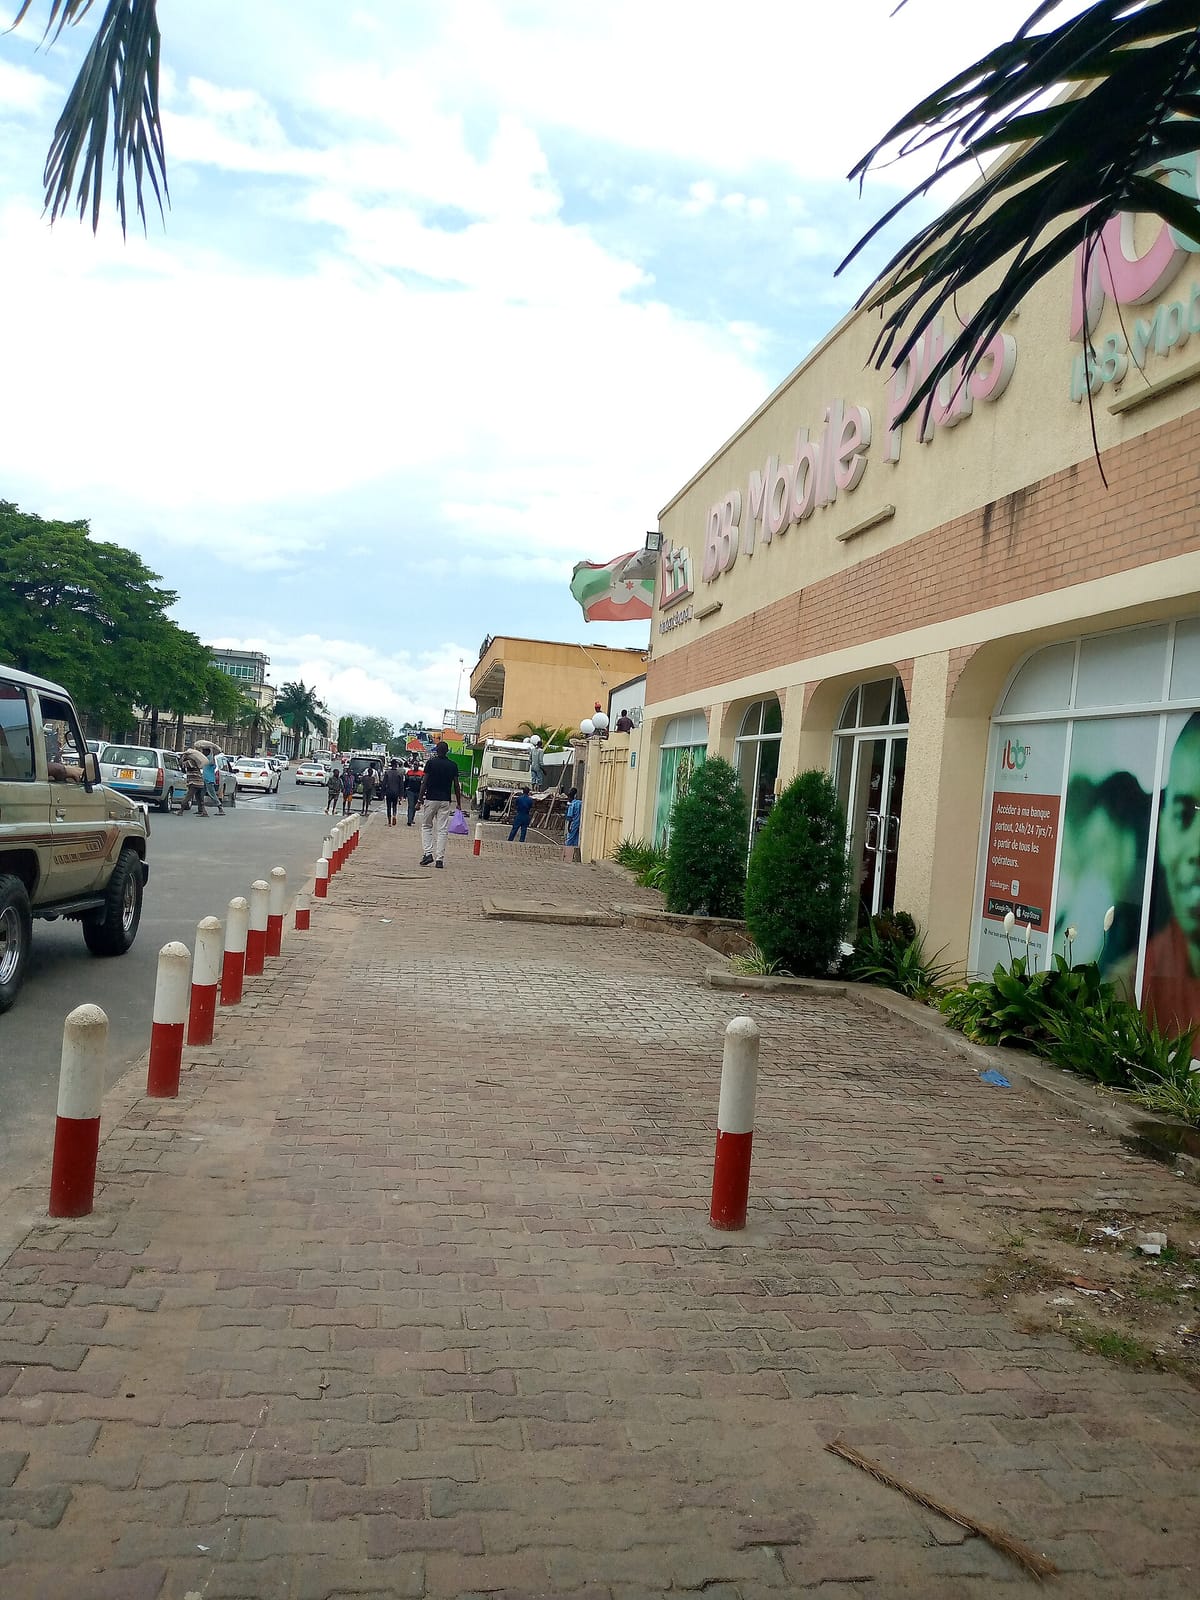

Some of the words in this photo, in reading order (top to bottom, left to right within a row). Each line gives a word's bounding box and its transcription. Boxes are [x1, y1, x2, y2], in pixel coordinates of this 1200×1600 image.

[743, 398, 872, 556] Mobile
[996, 803, 1017, 816] Accéder
[1022, 808, 1030, 817] ma
[1030, 805, 1051, 820] banque
[995, 822, 1013, 834] partout,
[1015, 822, 1034, 835] 24h/24
[997, 839, 1011, 851] partir
[1011, 839, 1018, 850] de
[1019, 842, 1031, 852] tous
[1031, 841, 1040, 854] les
[1022, 910, 1030, 921] App
[1030, 911, 1040, 921] Store
